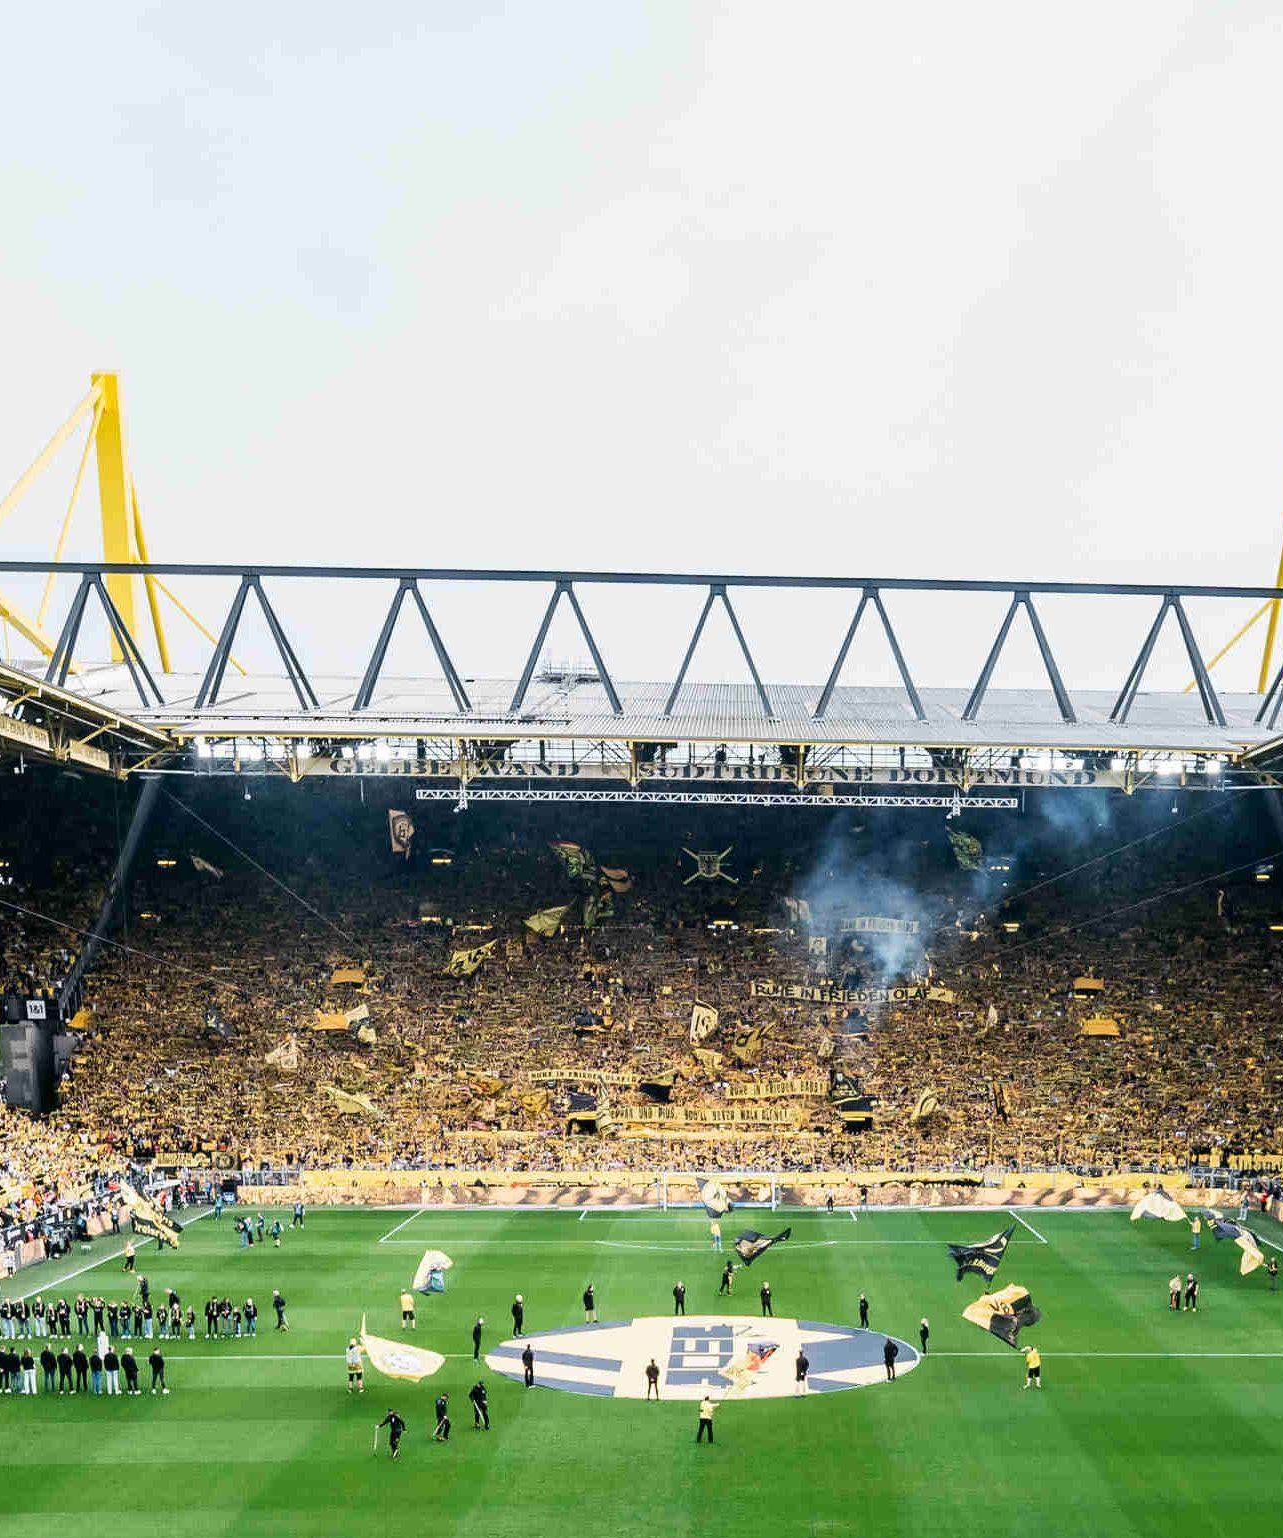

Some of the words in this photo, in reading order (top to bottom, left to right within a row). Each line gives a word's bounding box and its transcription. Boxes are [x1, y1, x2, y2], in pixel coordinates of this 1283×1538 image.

[330, 758, 451, 776] GELBE
[473, 761, 580, 777] WAND
[888, 767, 1098, 786] DORTMUND
[820, 988, 890, 1002] FRIEDEN
